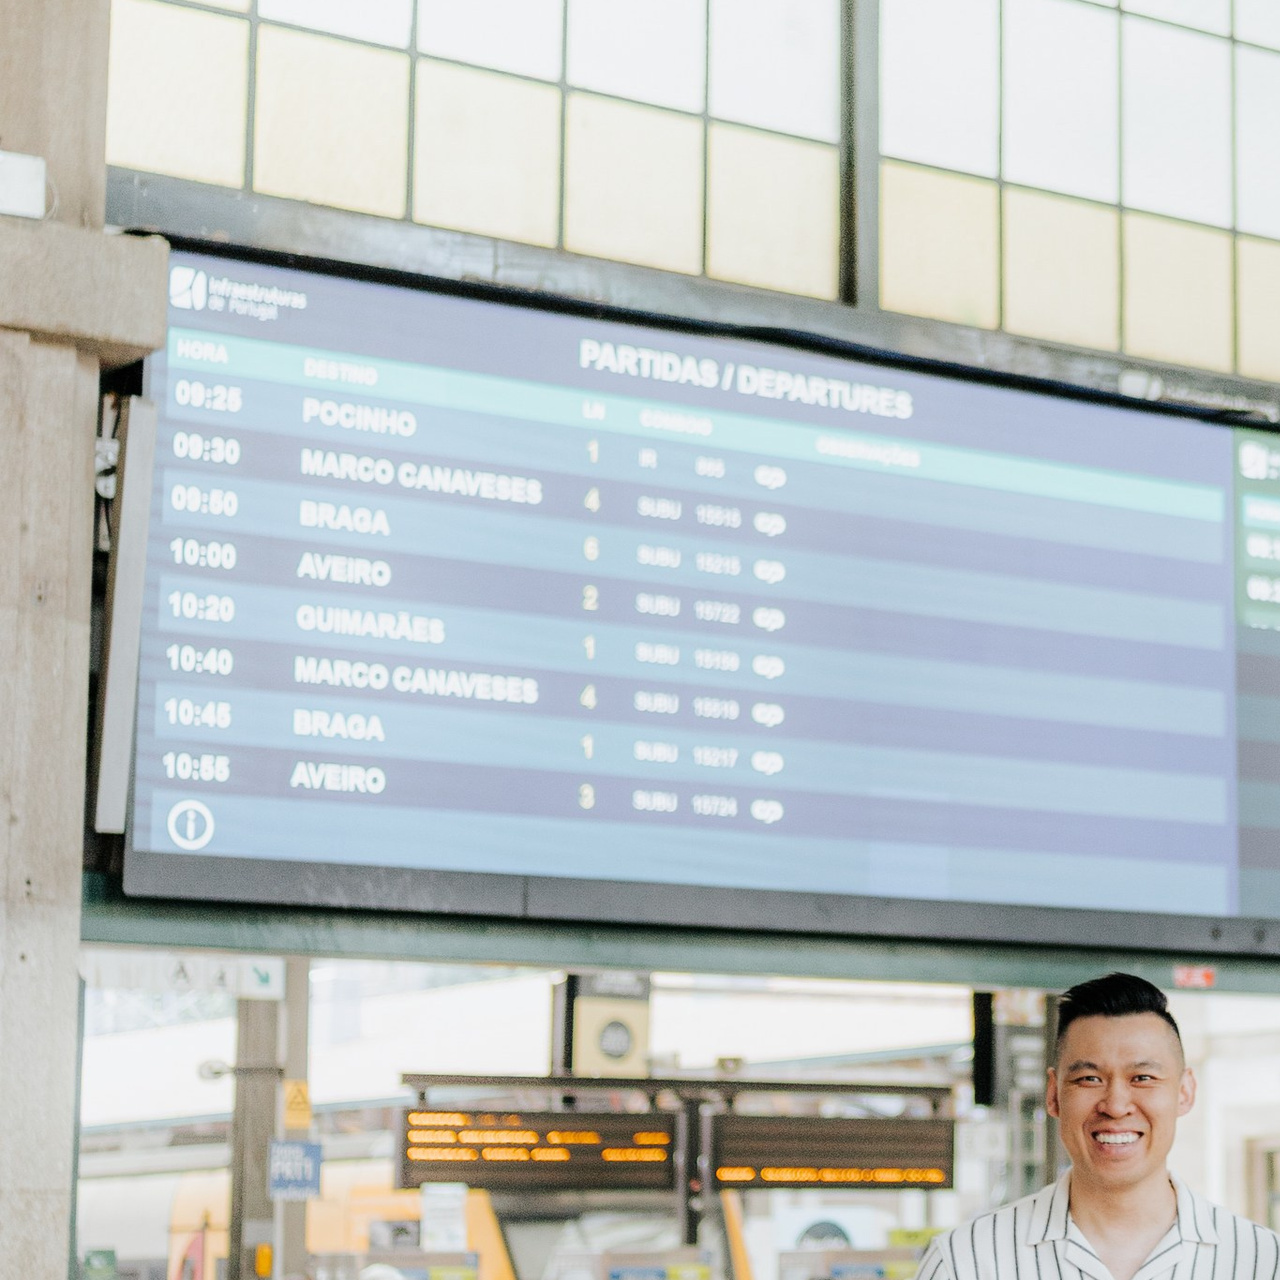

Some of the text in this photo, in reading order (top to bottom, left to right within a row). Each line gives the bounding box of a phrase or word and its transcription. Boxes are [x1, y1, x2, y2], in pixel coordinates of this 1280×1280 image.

[177, 339, 229, 364] HORA
[581, 340, 912, 419] PARTIDAS / DEPARTURES
[176, 381, 242, 412] 09:25
[303, 398, 416, 436] POCINHO
[588, 441, 598, 462] 1
[302, 449, 394, 485] MARCO
[399, 463, 542, 504] CANAVESES
[585, 489, 599, 511] 4
[301, 501, 389, 535] BRAGA
[171, 539, 236, 569] 10:00
[298, 553, 391, 586] AVEIRO
[584, 586, 597, 610] 2
[170, 592, 234, 621] 10:20
[297, 606, 444, 643] GUIMARÃES
[585, 637, 594, 659] 1
[167, 645, 232, 674] 10:40
[296, 657, 388, 690] MARCO
[393, 668, 538, 703] CANAVESES
[581, 686, 596, 708] 4
[166, 699, 230, 728] 10:45
[294, 710, 384, 741] BRAGA
[582, 736, 593, 758] 1
[164, 753, 229, 781] 10:55
[291, 763, 385, 793] AVEIRO
